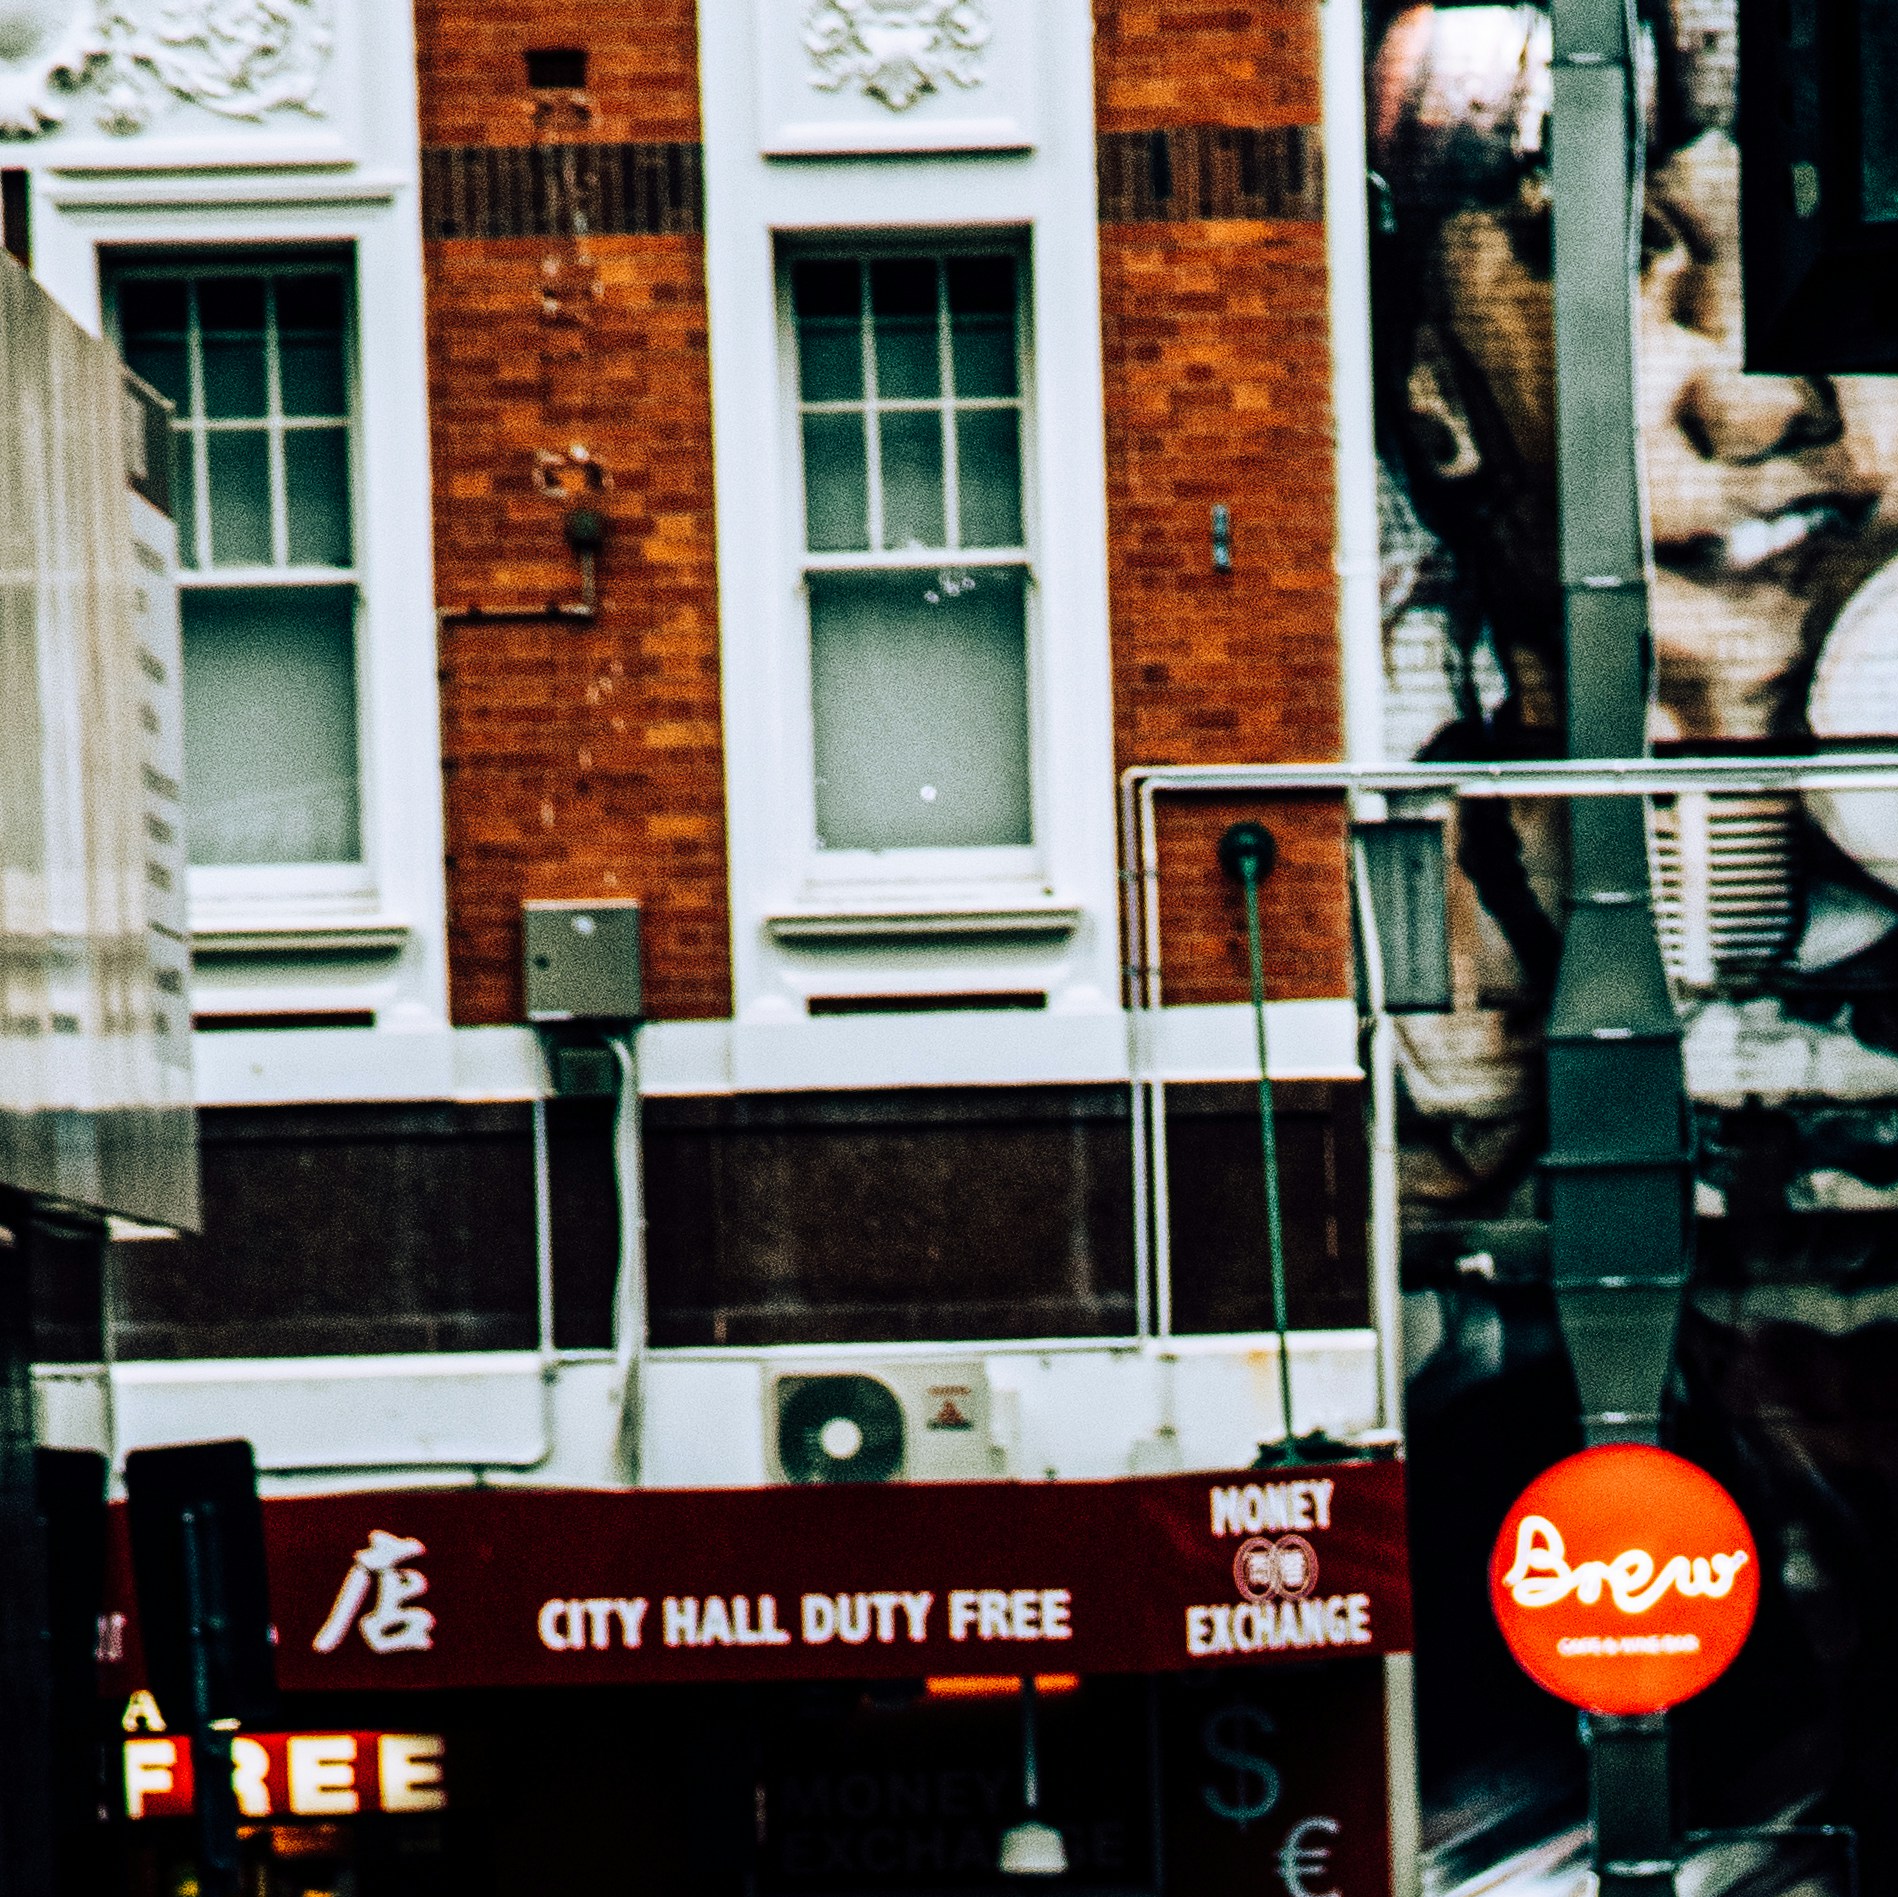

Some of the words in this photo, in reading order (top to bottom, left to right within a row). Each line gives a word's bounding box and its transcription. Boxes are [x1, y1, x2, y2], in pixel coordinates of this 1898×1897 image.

[1209, 1479, 1335, 1537] MONEY
[1504, 1515, 1748, 1614] Brew
[538, 1596, 649, 1651] CITY
[662, 1594, 792, 1647] HALL
[801, 1591, 935, 1645] DUTY
[948, 1588, 1074, 1642] FREE
[1186, 1593, 1373, 1656] EXCHANGE
[123, 1733, 447, 1819] FREE
